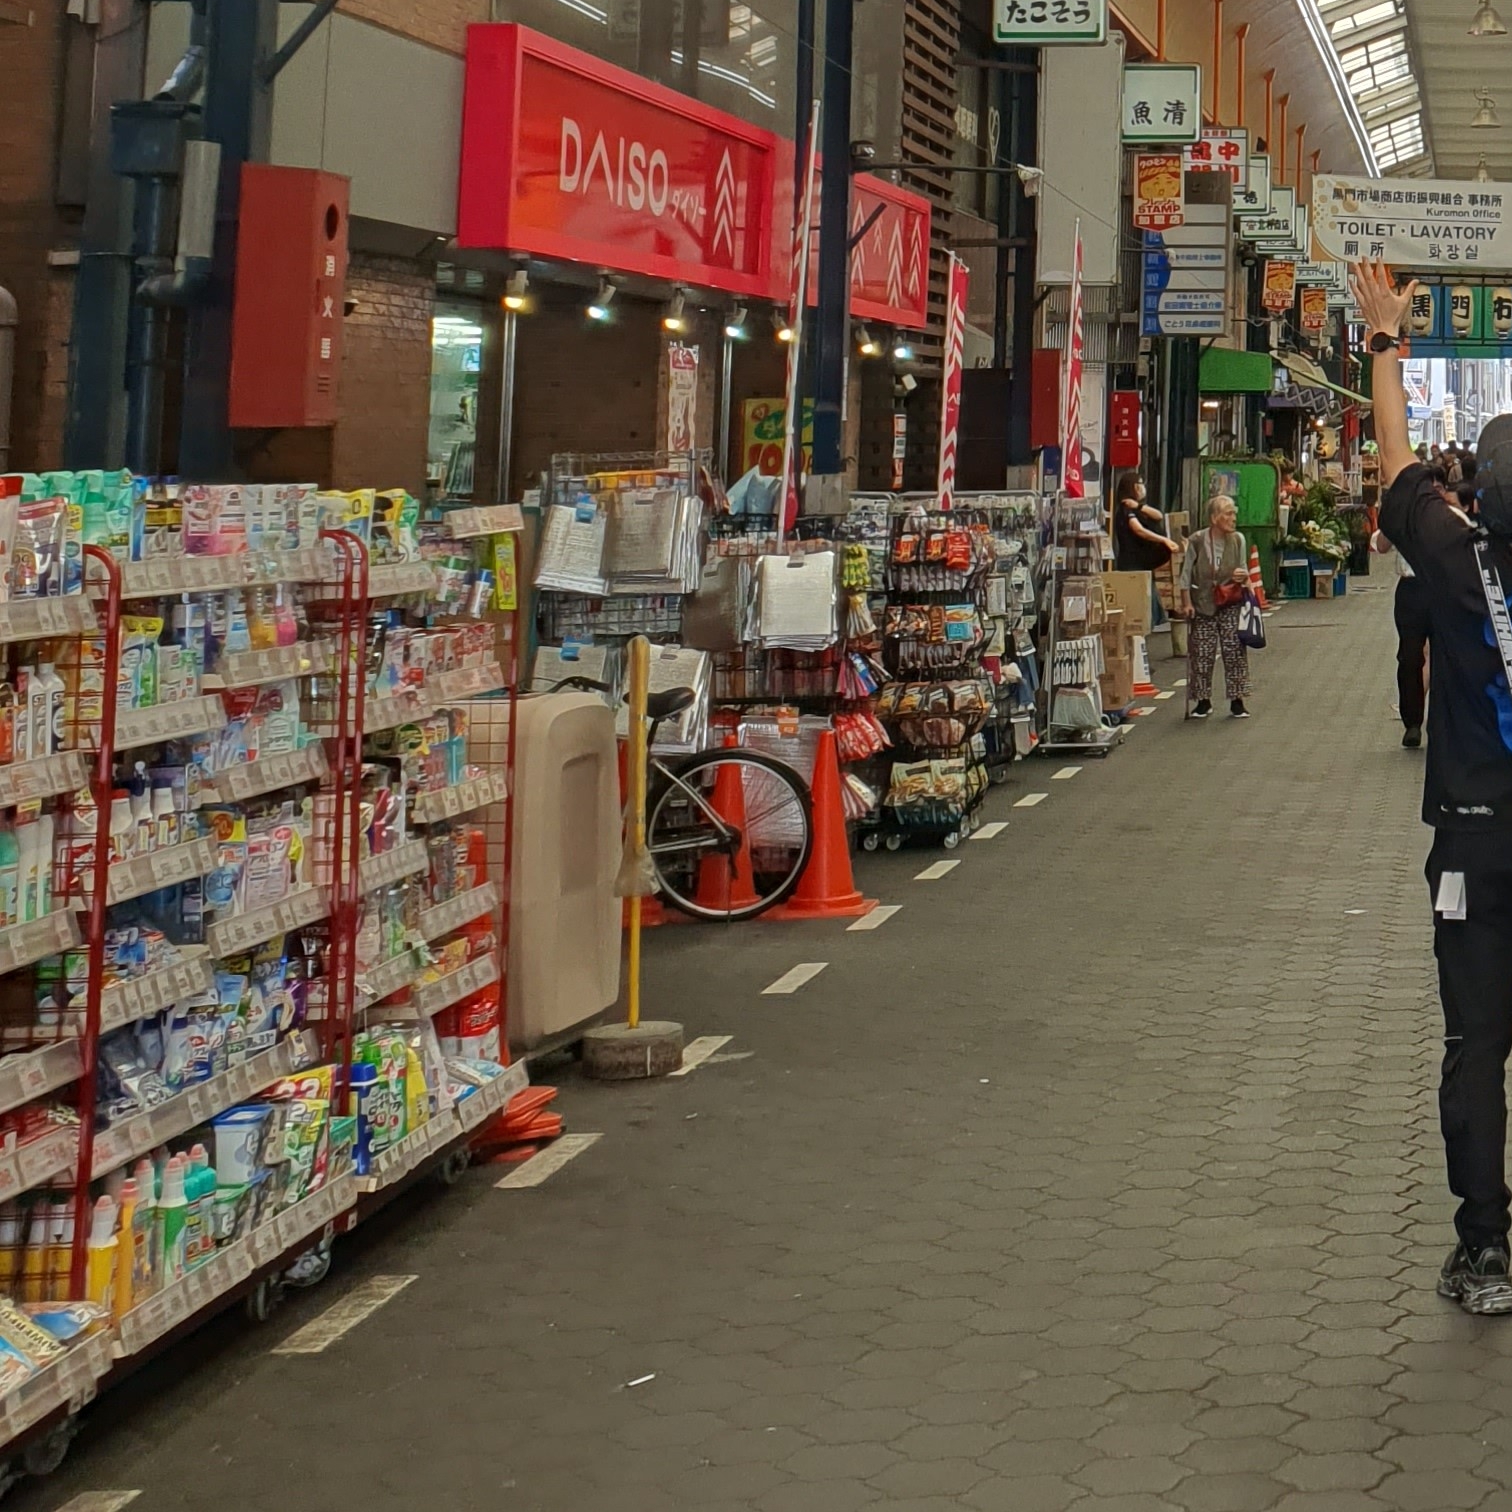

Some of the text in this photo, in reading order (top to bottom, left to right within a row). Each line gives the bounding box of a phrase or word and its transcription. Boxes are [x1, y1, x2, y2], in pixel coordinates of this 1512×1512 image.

[1006, 0, 1091, 25] たこそう
[1130, 99, 1188, 126] 魚清
[558, 116, 669, 217] DAISO
[671, 189, 707, 223] ダイソー
[1332, 188, 1502, 207] 黒門市場商店街振興組合 事務所
[1138, 205, 1181, 214] STAMP
[1426, 207, 1501, 219] Kuromon Office
[1336, 221, 1497, 240] TOILET LAVATORY
[1428, 243, 1479, 260] 화장실
